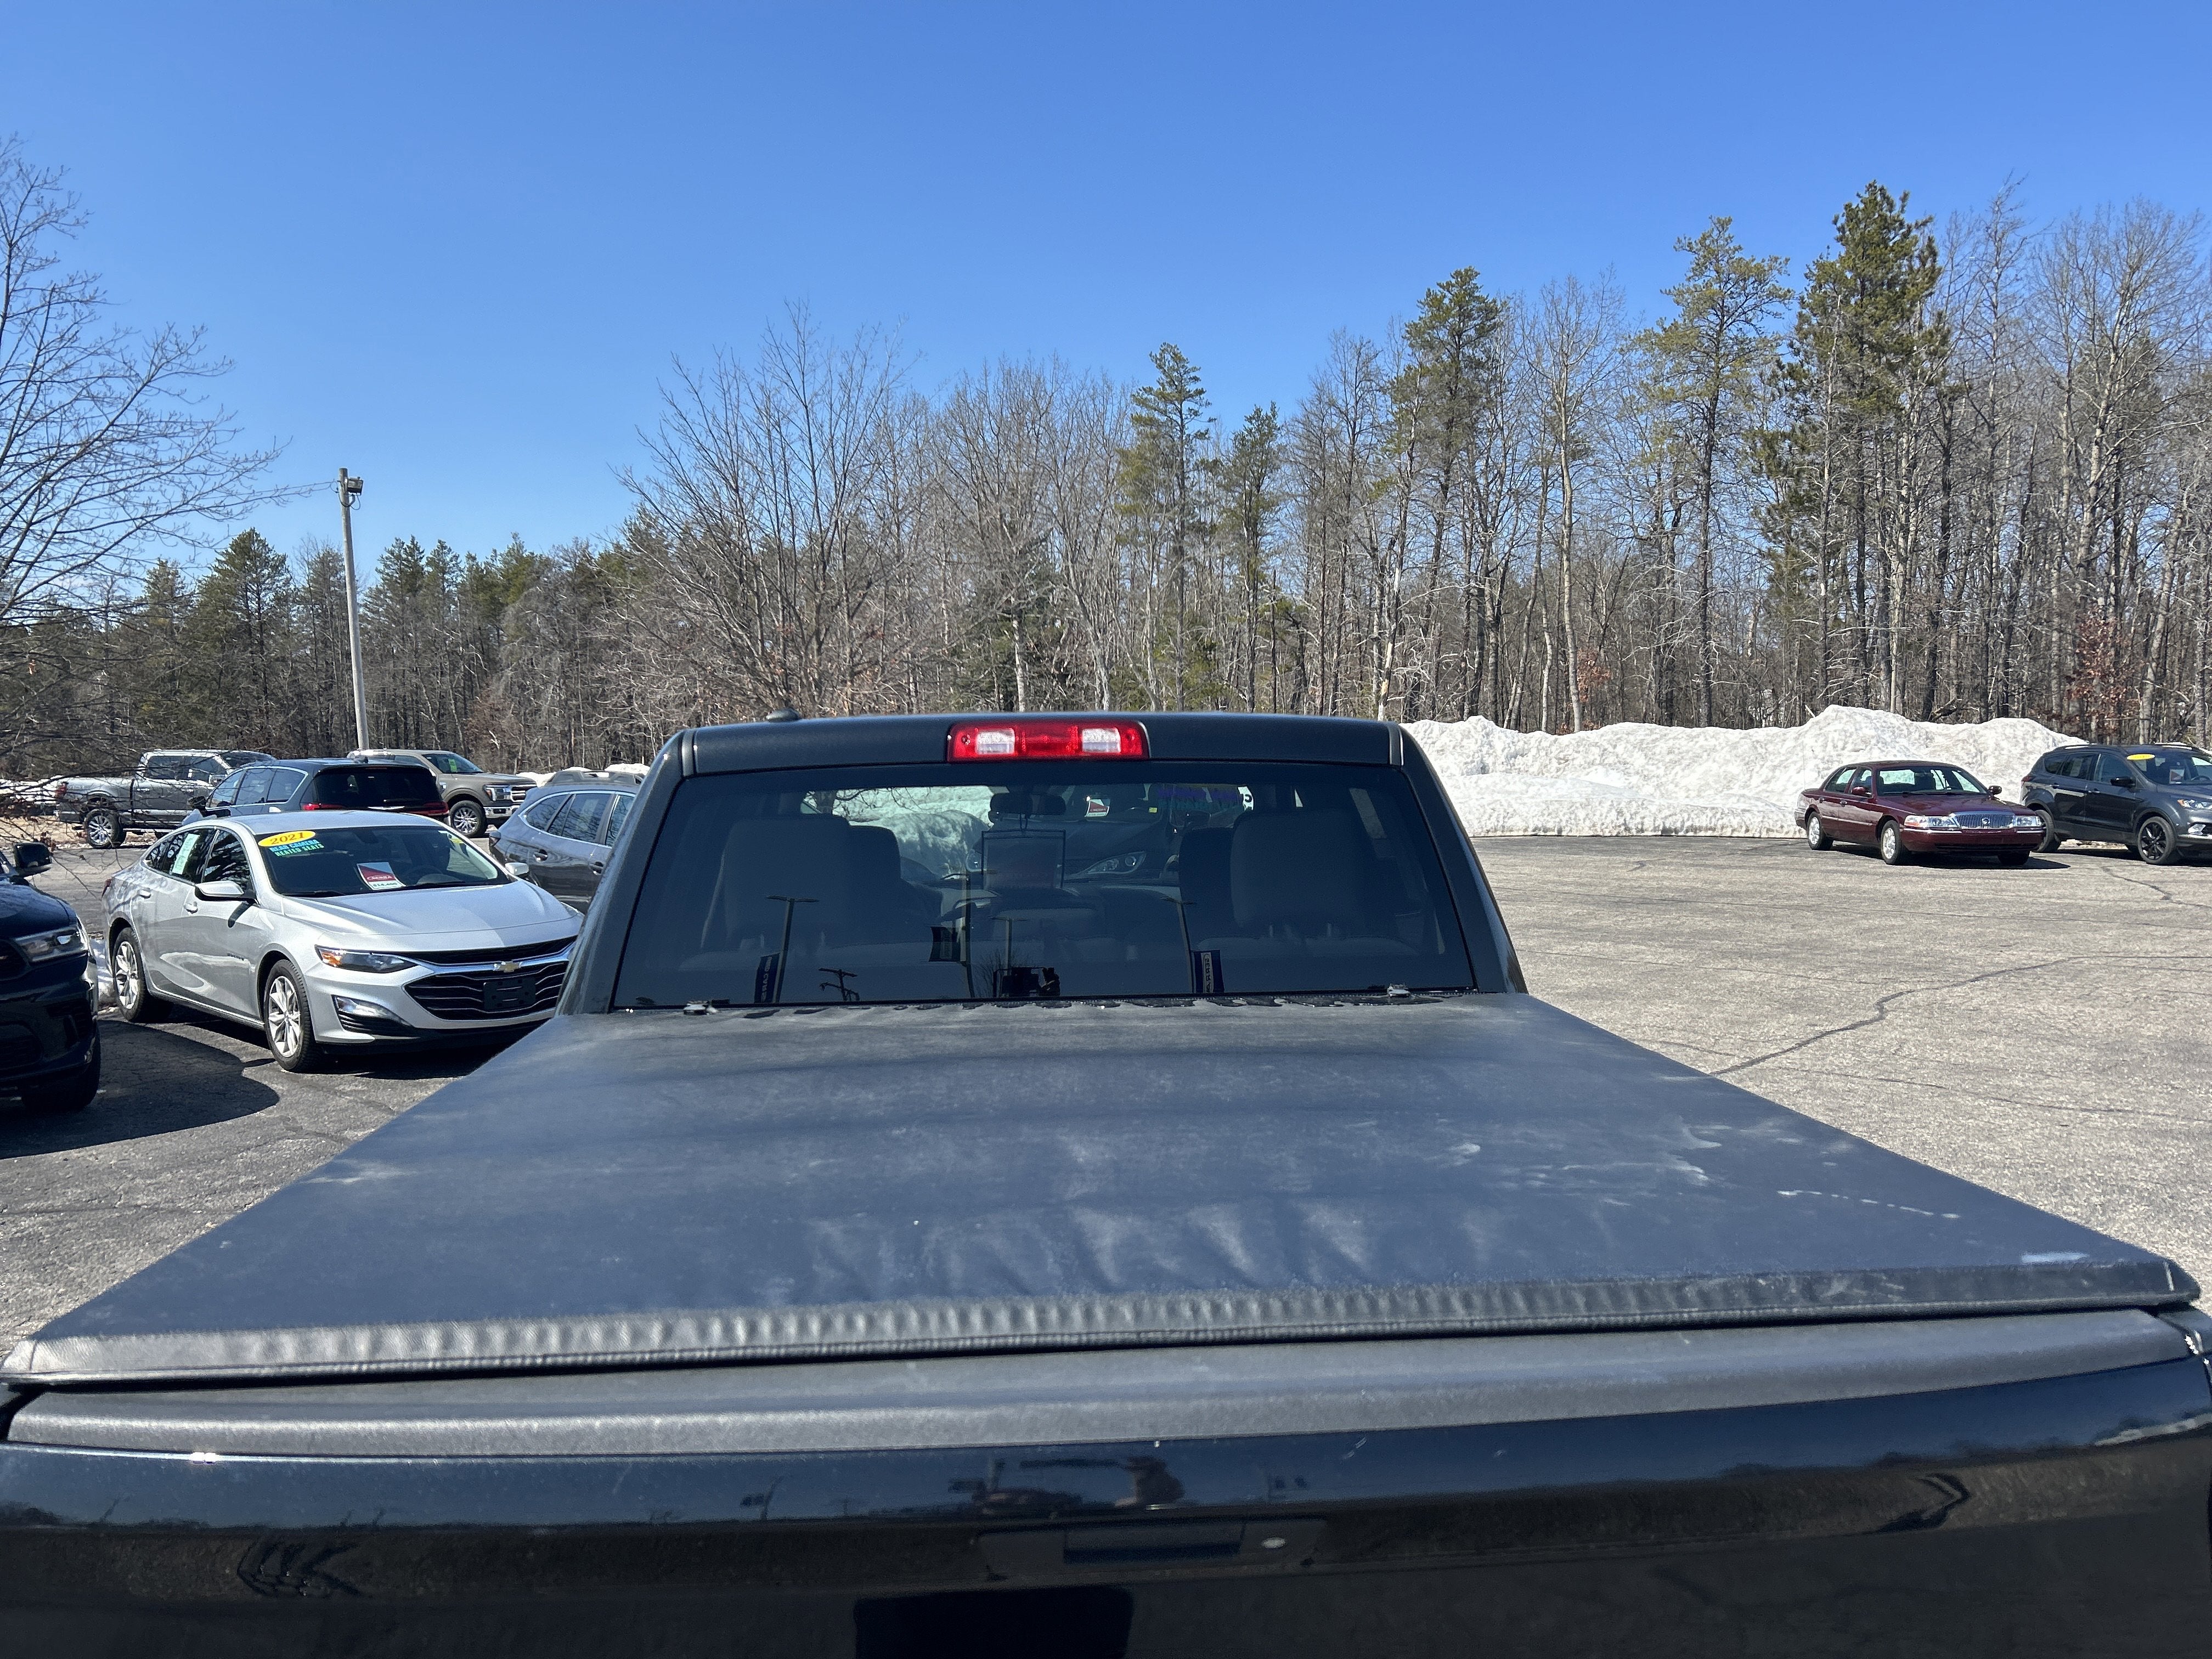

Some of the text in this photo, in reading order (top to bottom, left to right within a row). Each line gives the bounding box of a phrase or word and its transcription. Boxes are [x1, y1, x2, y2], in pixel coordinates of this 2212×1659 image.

[270, 832, 304, 844] 2021
[289, 839, 320, 848] CAMERA
[274, 848, 302, 856] HEATED
